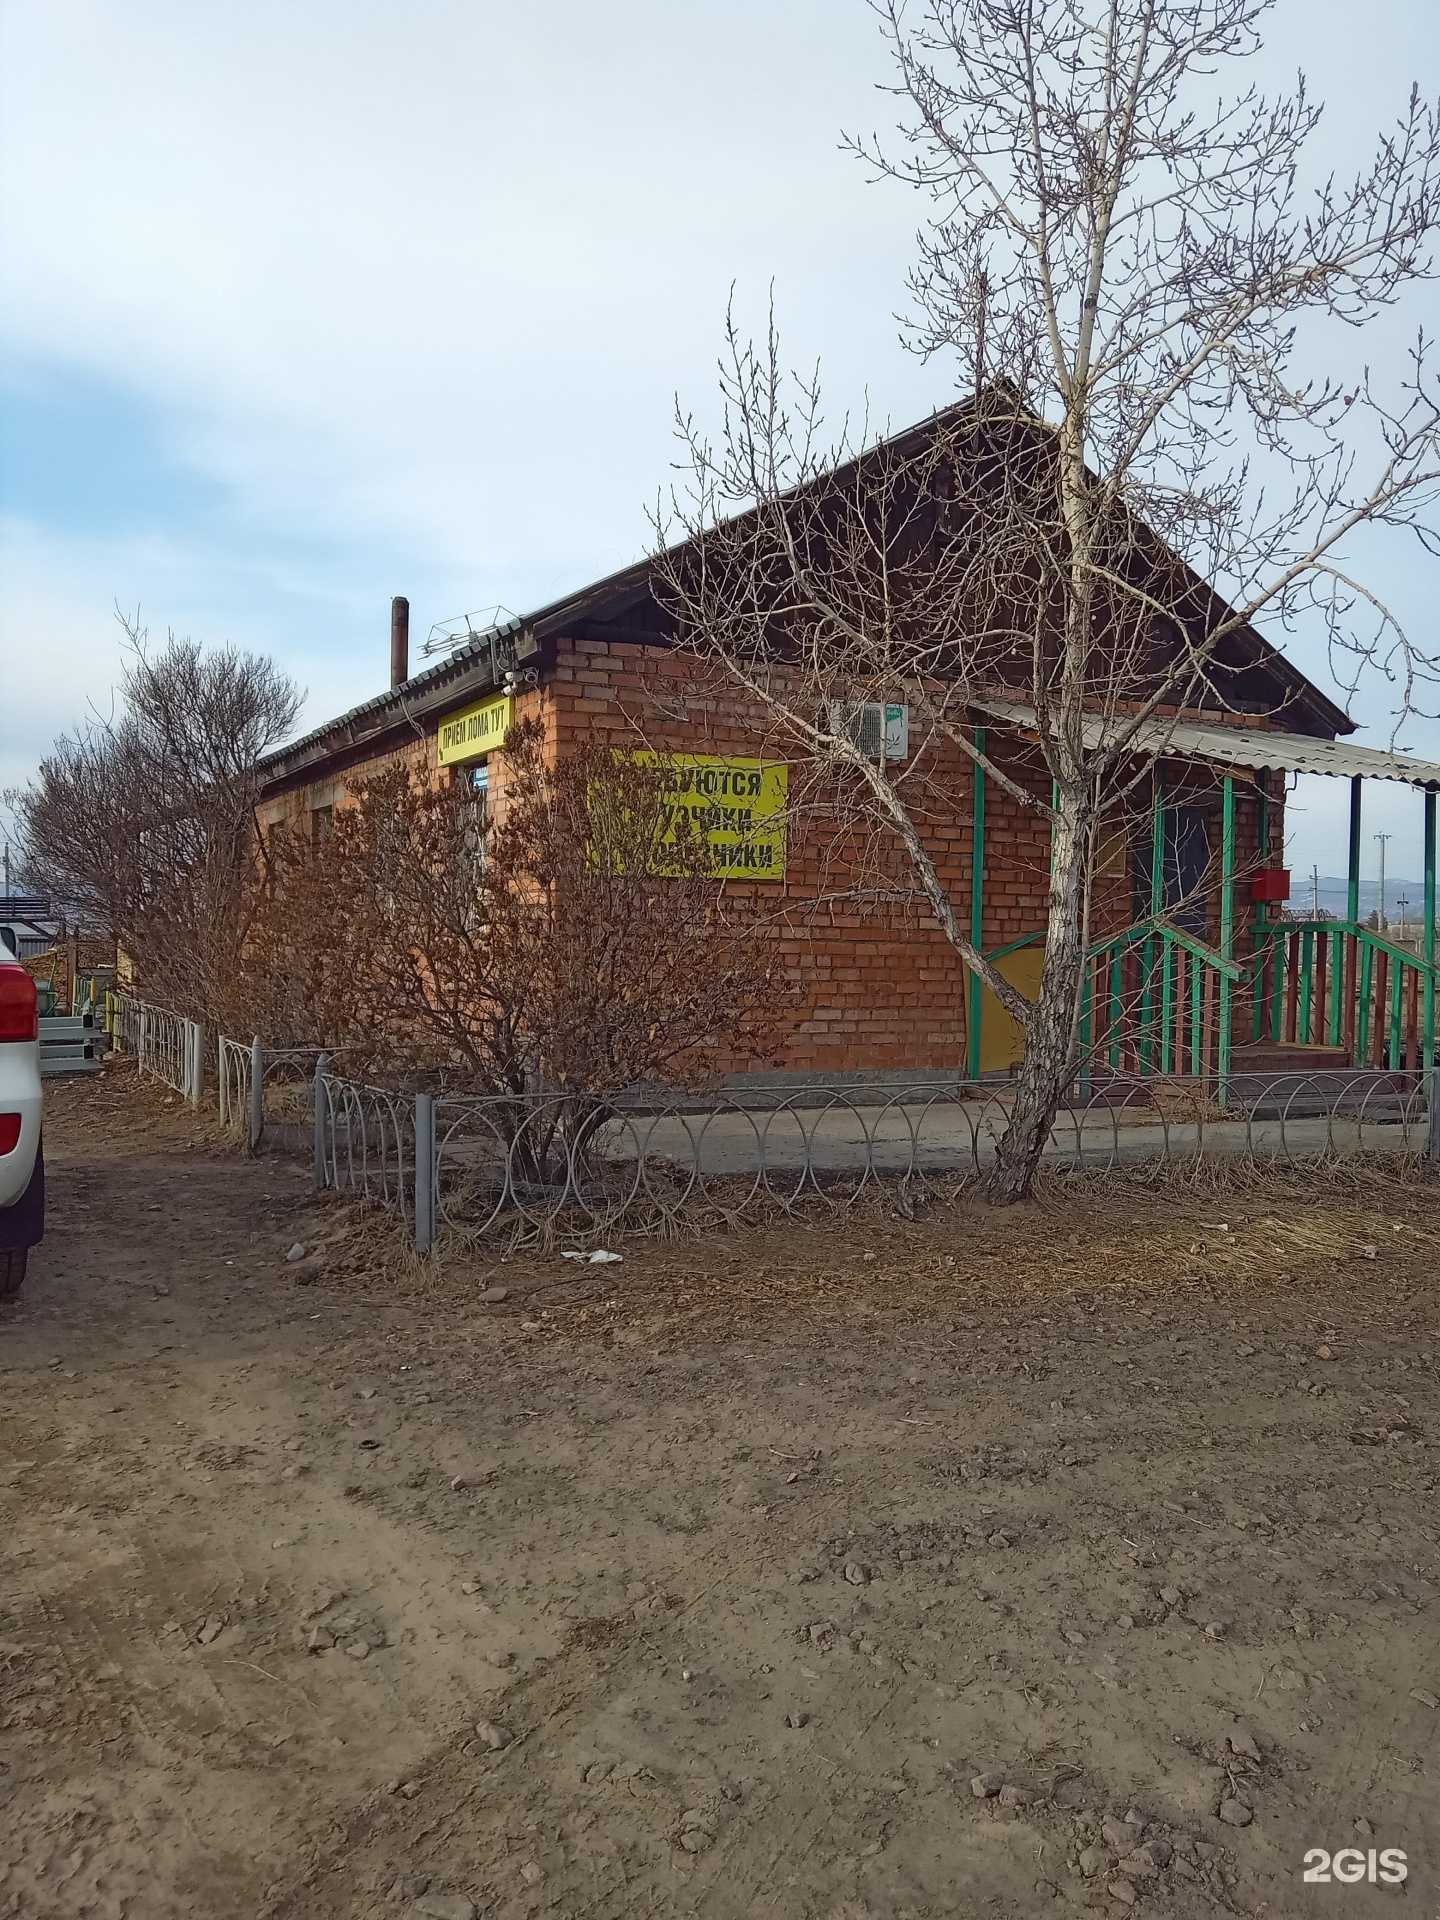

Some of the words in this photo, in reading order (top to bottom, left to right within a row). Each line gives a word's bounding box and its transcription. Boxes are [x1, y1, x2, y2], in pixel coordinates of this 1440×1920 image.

[443, 720, 466, 749] ПРИЕМ
[468, 711, 489, 742] ЛОМА
[491, 704, 505, 733] ТУТ
